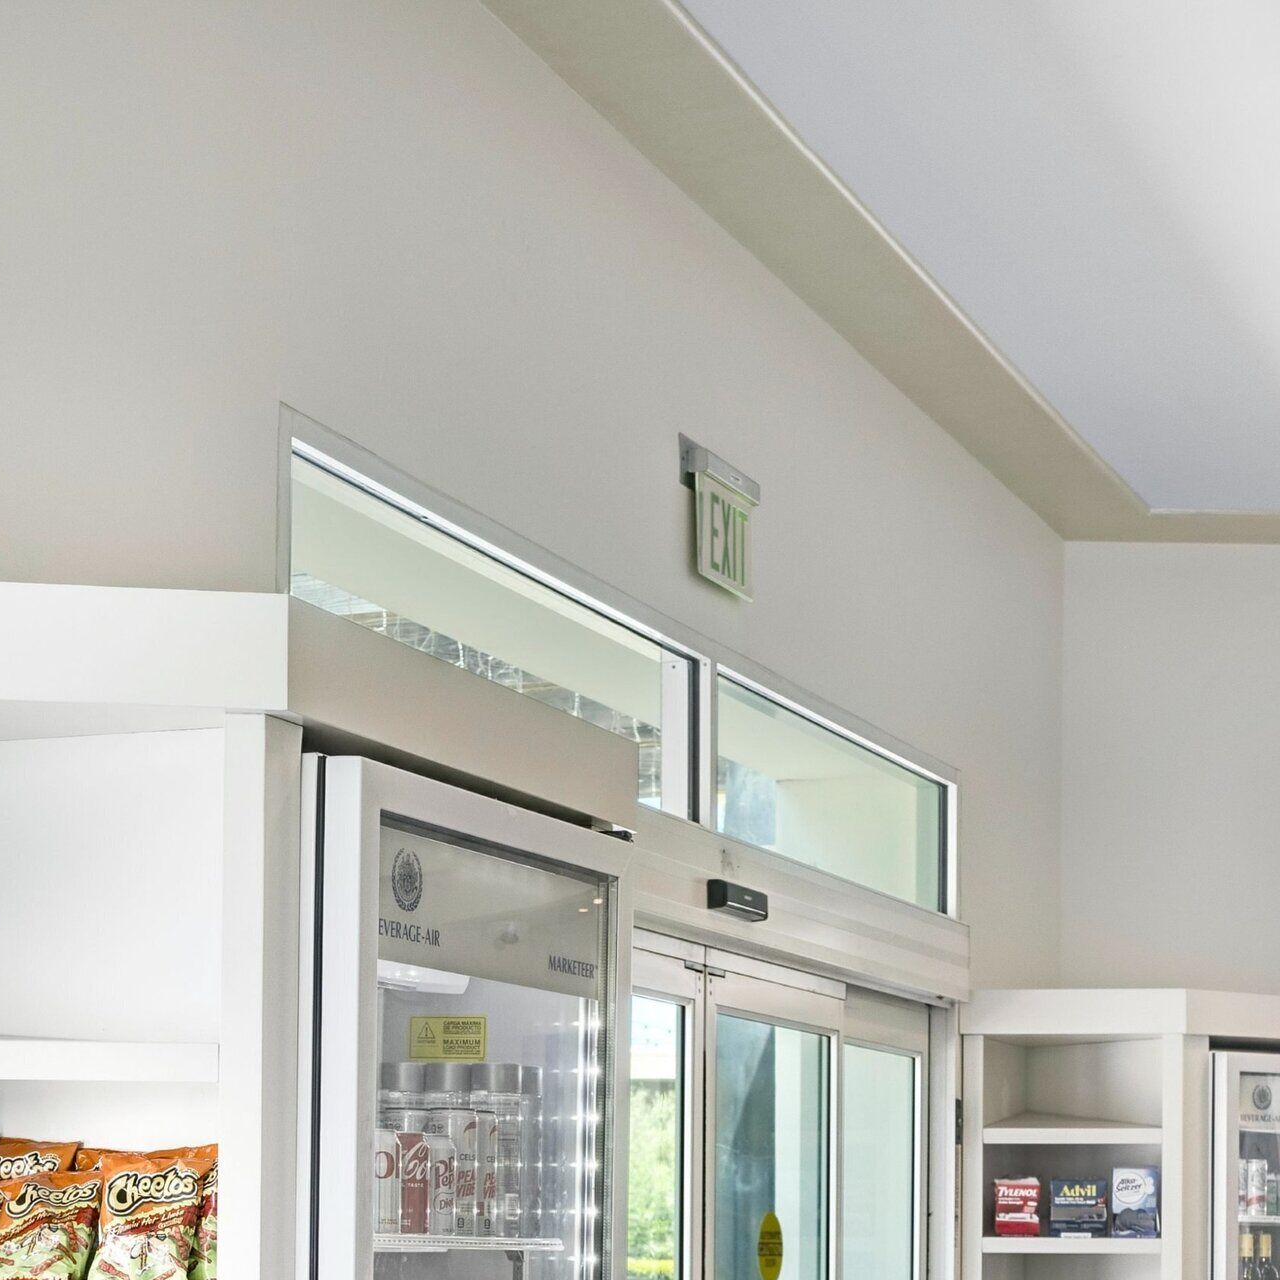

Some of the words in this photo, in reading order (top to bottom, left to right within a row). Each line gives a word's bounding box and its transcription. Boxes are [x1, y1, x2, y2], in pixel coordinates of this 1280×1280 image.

[709, 491, 749, 588] EXIT
[378, 917, 441, 947] EVERAGE-AIR
[548, 954, 595, 979] MARKETEER
[5, 1181, 101, 1217] Cheetos
[107, 1166, 196, 1214] Cheetos
[998, 1186, 1038, 1198] TYLENOL
[1060, 1184, 1097, 1197] Advil
